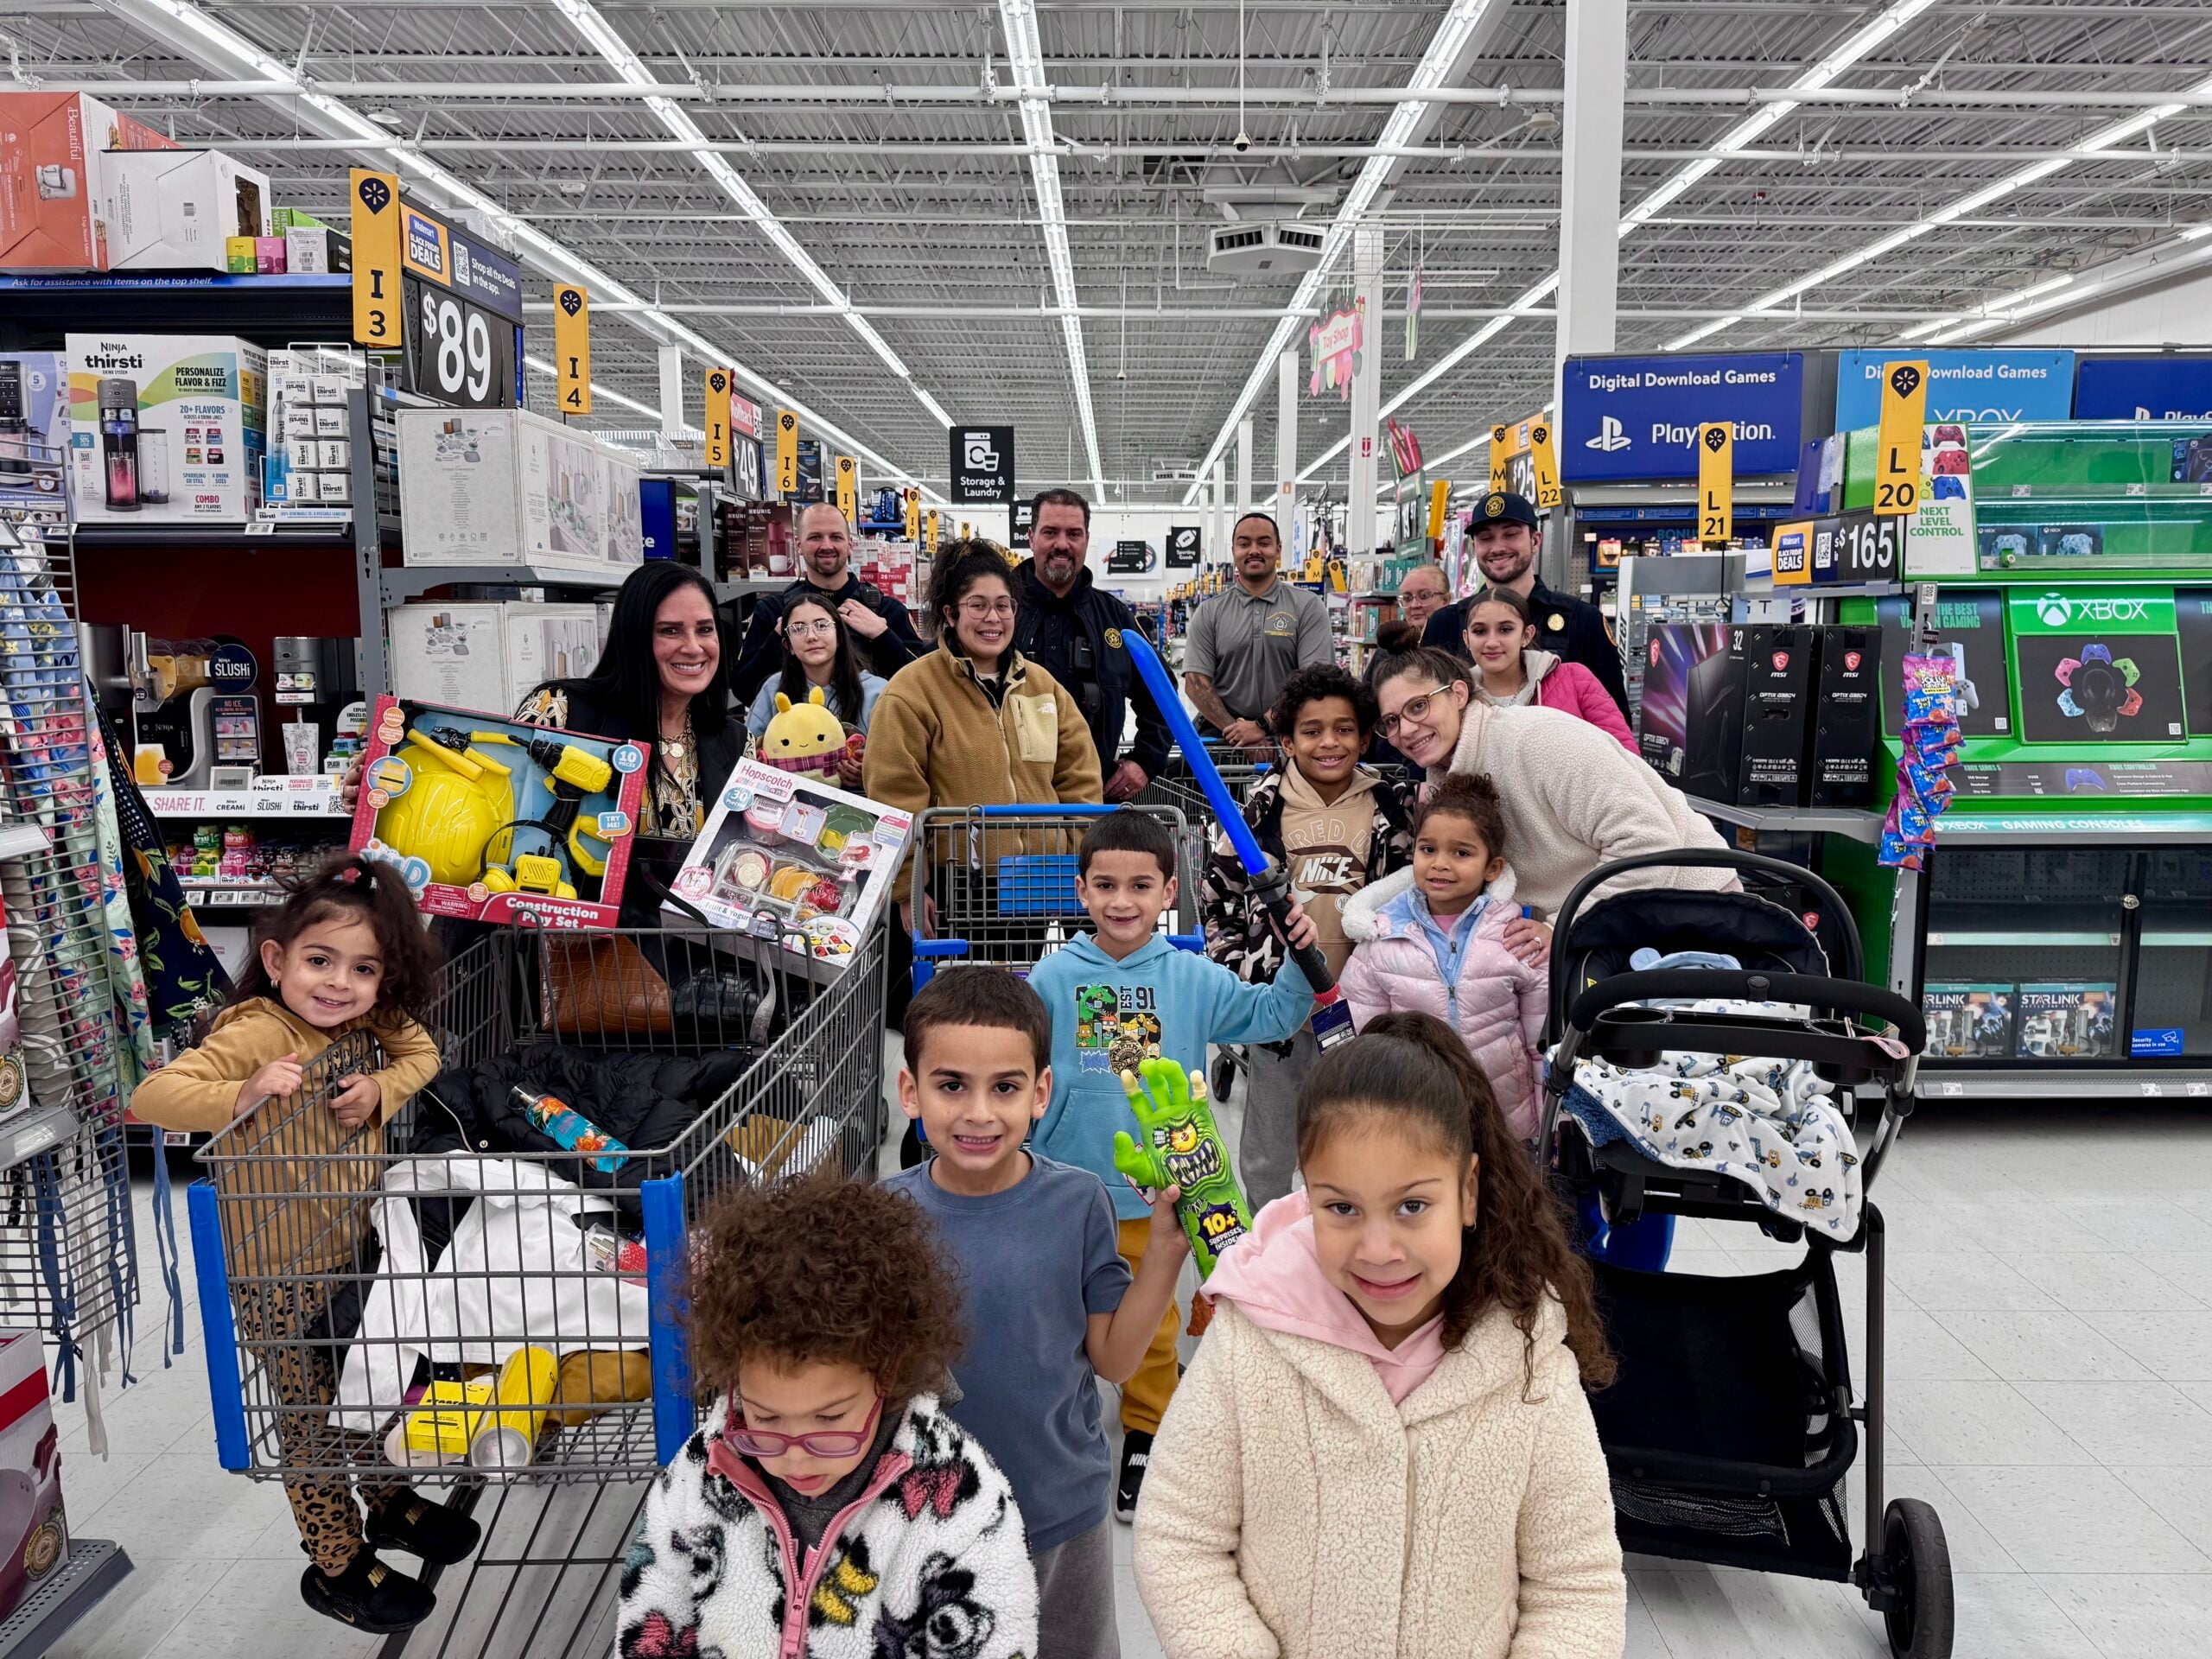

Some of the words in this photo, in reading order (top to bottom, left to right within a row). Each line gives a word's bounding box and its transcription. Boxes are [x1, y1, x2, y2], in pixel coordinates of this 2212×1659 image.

[67, 106, 82, 161] Beautiful
[413, 219, 435, 239] Walmart
[410, 234, 424, 247] BLACK
[424, 238, 440, 254] FRIDAY
[410, 244, 441, 270] DEALS
[472, 257, 486, 275] Shop
[493, 268, 502, 283] the
[501, 271, 516, 289] Deals
[12, 278, 29, 287] Ask
[29, 278, 44, 287] for
[92, 277, 112, 286] with
[114, 277, 140, 286] items
[171, 277, 188, 288] top
[189, 276, 213, 285] shelf.
[371, 270, 384, 299] I
[472, 272, 479, 285] in
[478, 275, 488, 289] the
[487, 281, 500, 295] app.
[368, 310, 386, 337] 3
[1323, 336, 1332, 349] Toy
[1333, 327, 1349, 344] Shop
[100, 341, 128, 353] NINJA
[422, 292, 491, 403] $89
[85, 353, 144, 369] thirsti
[569, 357, 579, 379] I
[175, 366, 225, 377] PERSONALIZE
[1997, 365, 2047, 379] Games
[33, 375, 40, 385] 5
[175, 378, 203, 387] FLAVOR
[204, 378, 211, 387] &
[212, 378, 227, 387] FIZZ
[1589, 373, 1640, 392] Digital
[1644, 371, 1720, 387] Download
[1725, 370, 1777, 384] Games
[566, 387, 582, 408] 4
[180, 405, 194, 414] 20+
[194, 405, 226, 414] FLAVORS
[714, 423, 721, 440] I
[712, 446, 722, 461] 5
[1890, 448, 1907, 474] L
[1491, 467, 1507, 481] M
[1541, 471, 1552, 485] L
[782, 475, 791, 488] 6
[960, 476, 995, 488] Storage
[997, 476, 1006, 486] &
[195, 495, 219, 504] COMBO
[964, 487, 1002, 499] Laundry
[1540, 488, 1559, 505] 22
[1878, 483, 1915, 508] 20
[1707, 491, 1720, 511] L
[842, 508, 849, 518] 7
[1919, 506, 1951, 516] NEXT
[1704, 517, 1724, 536] 21
[1919, 517, 1953, 526] LEVEL
[1656, 528, 1699, 540] BONU
[1909, 527, 1964, 537] CONTROL
[1782, 537, 1801, 546] Walmart
[1840, 521, 1894, 569] $165
[1789, 548, 1803, 556] FRIDAY
[1777, 556, 1802, 571] DEALS
[1926, 585, 1935, 598] 200
[1936, 603, 1953, 614] THE
[1955, 602, 1978, 614] BEST
[2076, 598, 2149, 620] XBOX
[1942, 615, 1980, 628] GAMING
[1733, 630, 1744, 651] 32
[215, 663, 251, 677] SLUSHi
[1921, 675, 1946, 685] JOLLY
[1912, 696, 1934, 704] FRUITY
[619, 750, 638, 762] 10
[741, 765, 793, 790] Hopscotch
[730, 789, 748, 802] 30
[153, 797, 190, 811] SHARE
[193, 797, 206, 810] IT.
[257, 801, 283, 810] SLUSHi
[293, 802, 321, 811] thirsti
[1948, 820, 1987, 830] XBOX
[2001, 819, 2066, 830] GAMING
[2067, 819, 2145, 830] CONSOLES
[1297, 856, 1354, 885] NIKE
[505, 897, 599, 920] Construction
[556, 916, 580, 928] Set
[1120, 985, 1132, 1009] EST
[1135, 986, 1157, 1010] 91
[2021, 994, 2081, 1005] STARLINK
[1203, 1212, 1236, 1236] 10+
[1208, 1226, 1243, 1246] SURPRISES
[1215, 1235, 1240, 1251] INSIDE!
